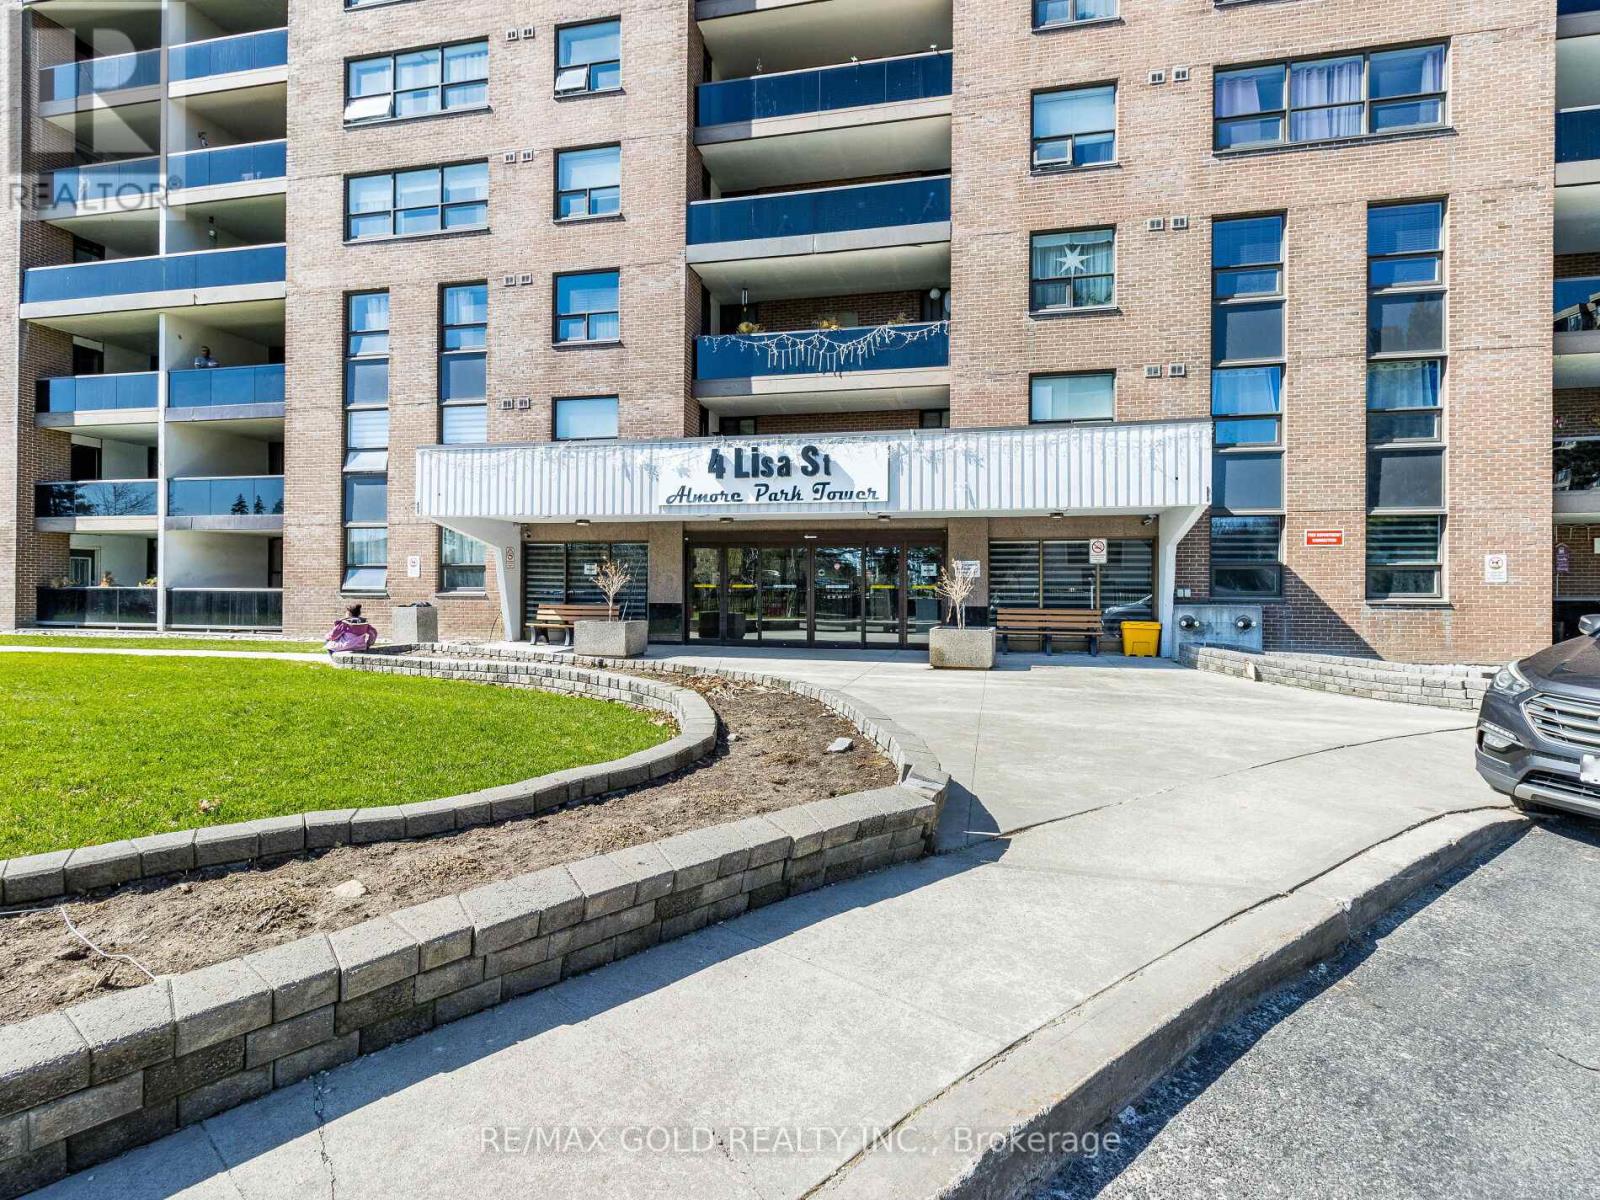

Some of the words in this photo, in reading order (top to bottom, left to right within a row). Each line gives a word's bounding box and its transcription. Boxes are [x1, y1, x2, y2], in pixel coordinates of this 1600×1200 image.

[708, 447, 726, 480] 4
[734, 446, 792, 479] Lisa
[801, 445, 832, 477] St
[665, 485, 744, 505] Almore
[753, 483, 804, 502] Park
[812, 481, 880, 501] Tower
